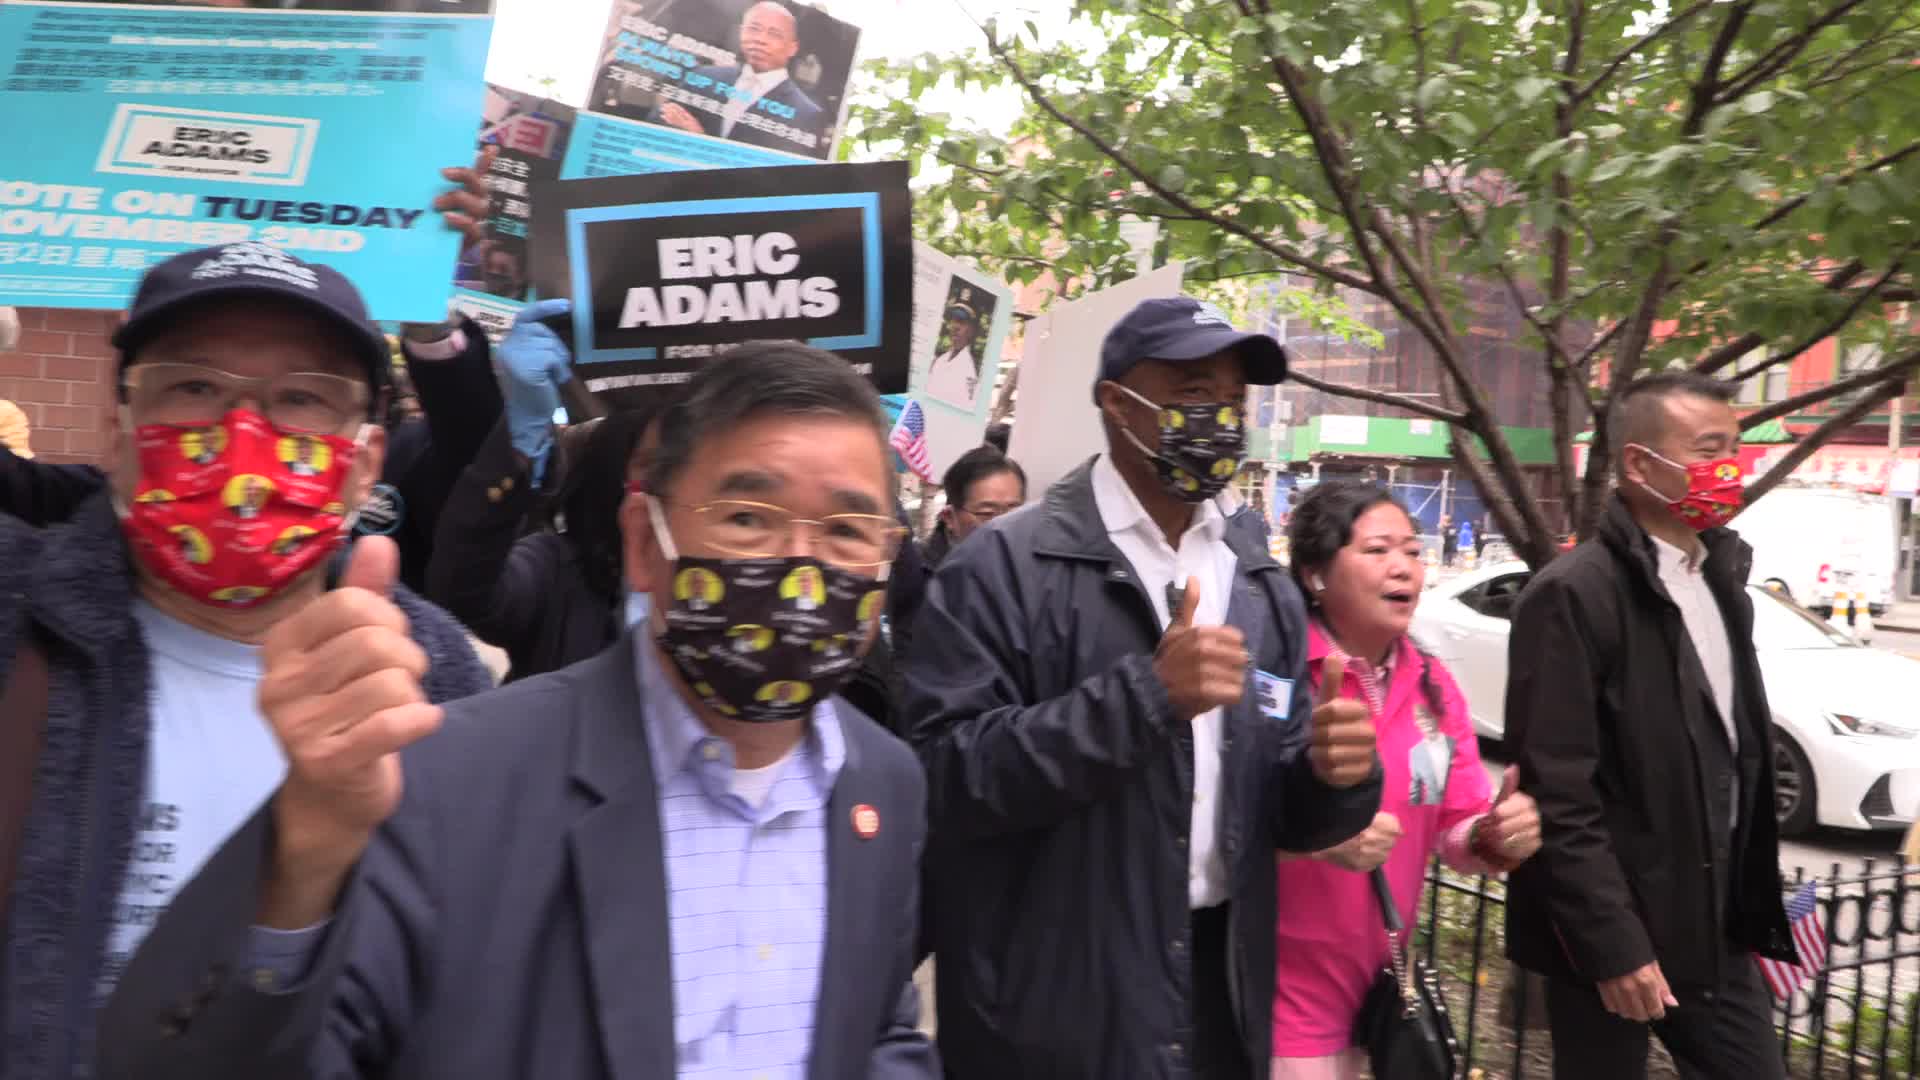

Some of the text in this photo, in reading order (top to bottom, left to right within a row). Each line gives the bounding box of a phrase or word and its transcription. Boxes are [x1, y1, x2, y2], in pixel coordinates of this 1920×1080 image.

[685, 71, 713, 88] UP
[757, 96, 796, 119] YOU
[141, 141, 272, 164] ADAMS
[173, 126, 252, 146] ERIC
[0, 181, 425, 229] OTE ON TUESDAY
[0, 208, 366, 252] OVEMBER 2ND
[657, 232, 800, 279] ERIC
[617, 276, 840, 328] ADAMS
[664, 345, 712, 359] FOR
